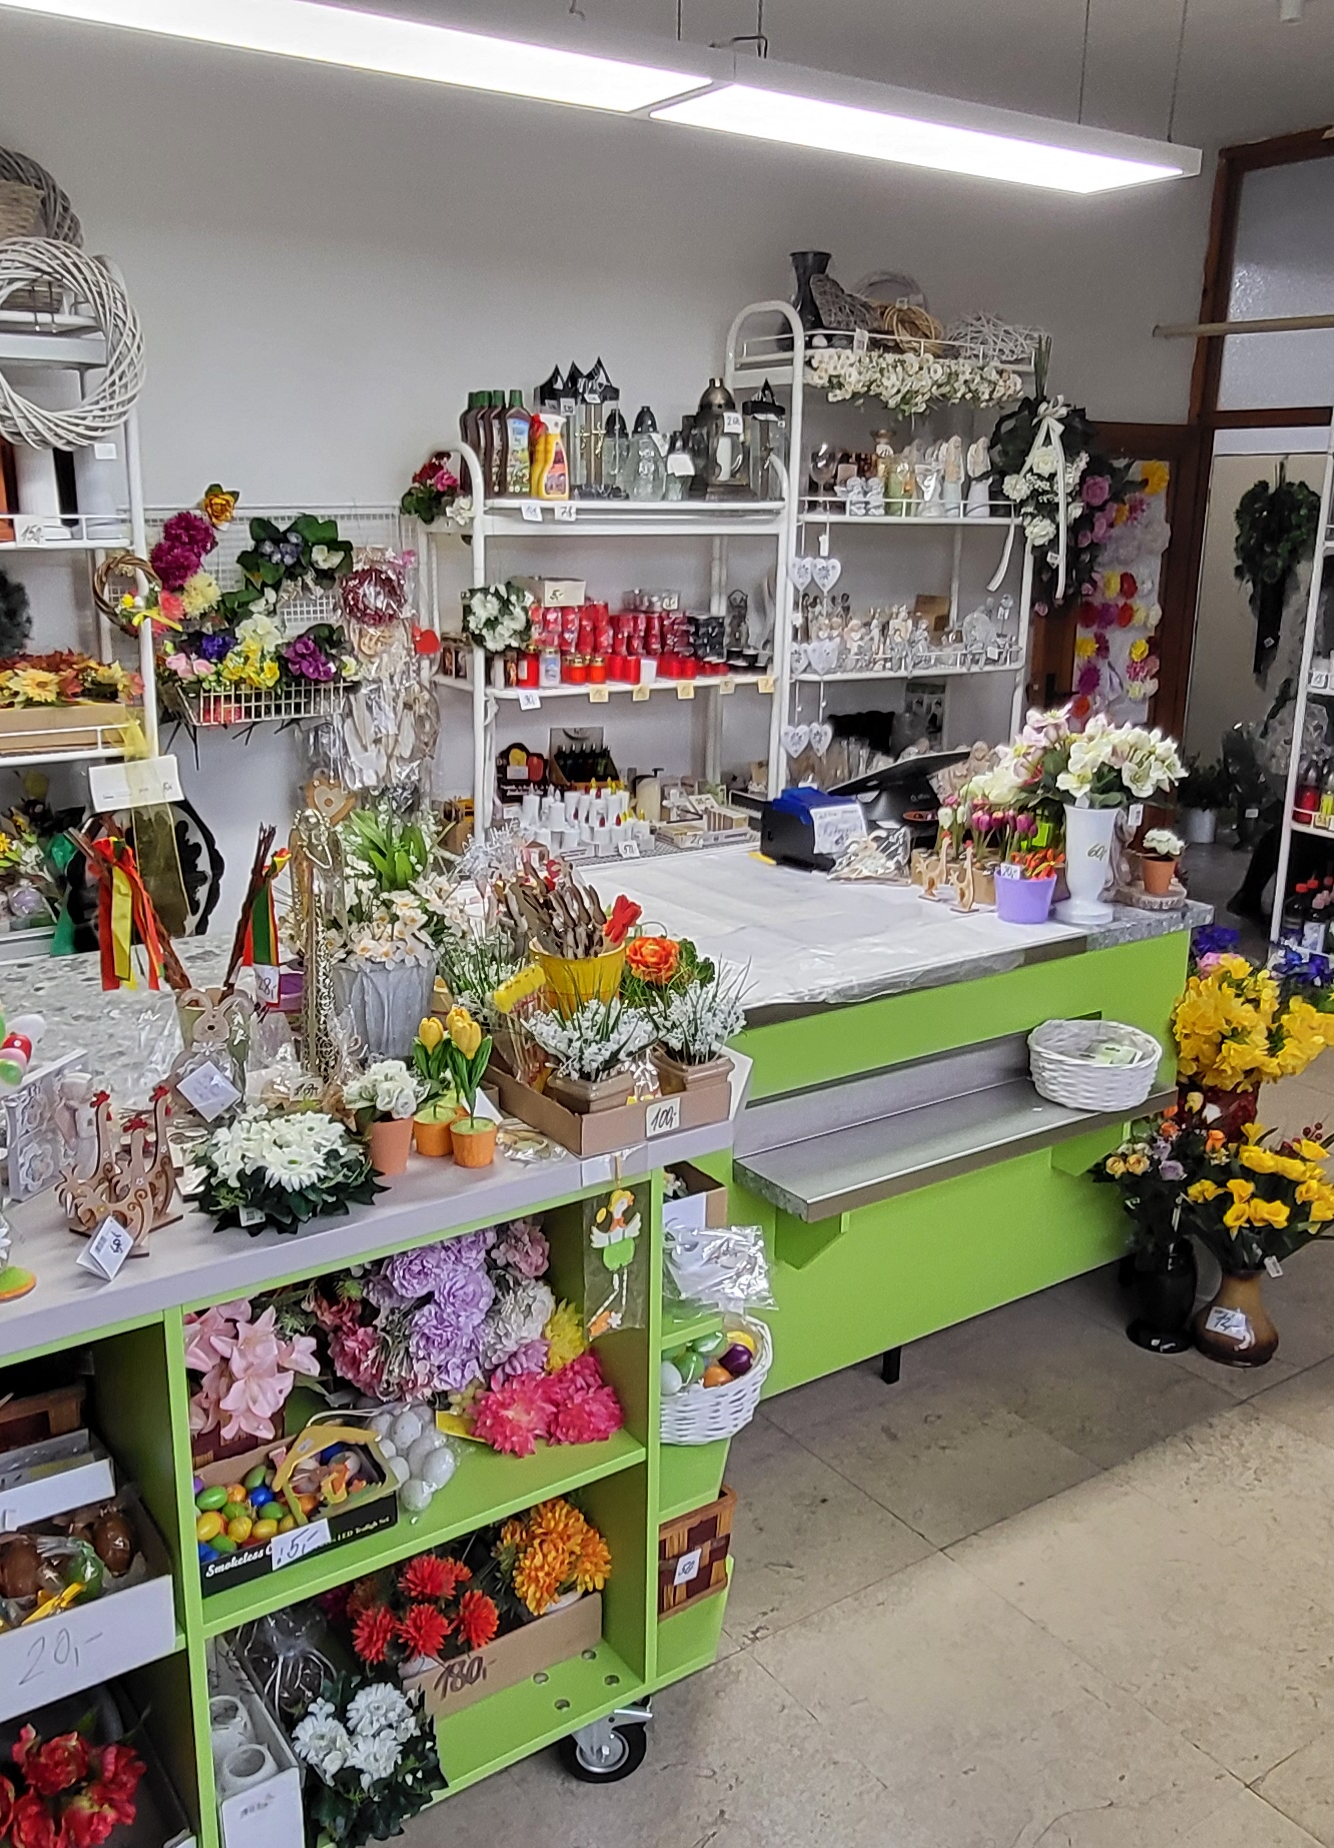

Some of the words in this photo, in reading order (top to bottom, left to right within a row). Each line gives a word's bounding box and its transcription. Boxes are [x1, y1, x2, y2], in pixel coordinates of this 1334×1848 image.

[206, 1550, 265, 1578] Smokeless
[19, 1628, 104, 1687] 20,-
[434, 1656, 496, 1702] 180,-
